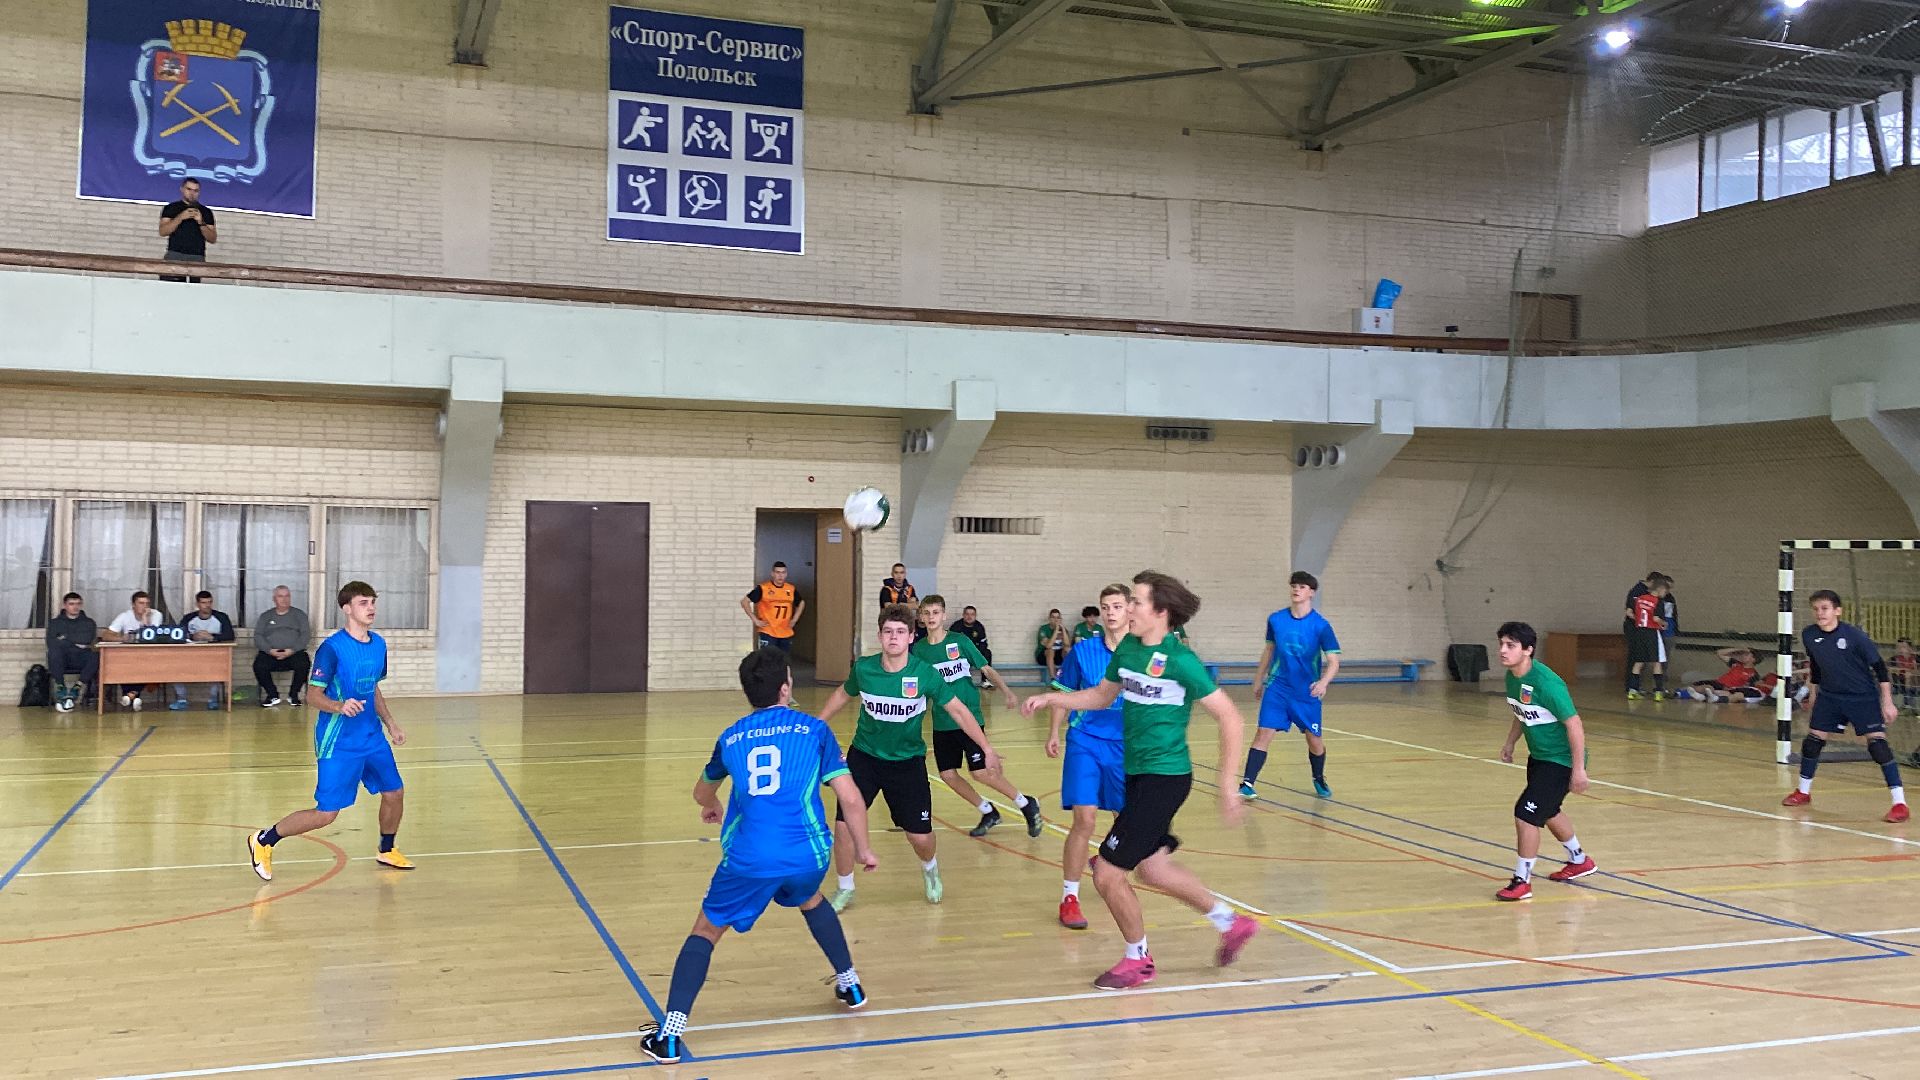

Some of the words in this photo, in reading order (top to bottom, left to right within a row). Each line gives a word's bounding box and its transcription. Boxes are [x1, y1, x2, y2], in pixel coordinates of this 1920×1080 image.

[610, 20, 802, 62] «Спорт-Сервис»
[657, 57, 758, 87] Подольск
[774, 605, 788, 619] 77
[143, 628, 155, 640] 0
[171, 628, 183, 640] 0
[794, 723, 810, 735] 29
[746, 744, 782, 797] 8
